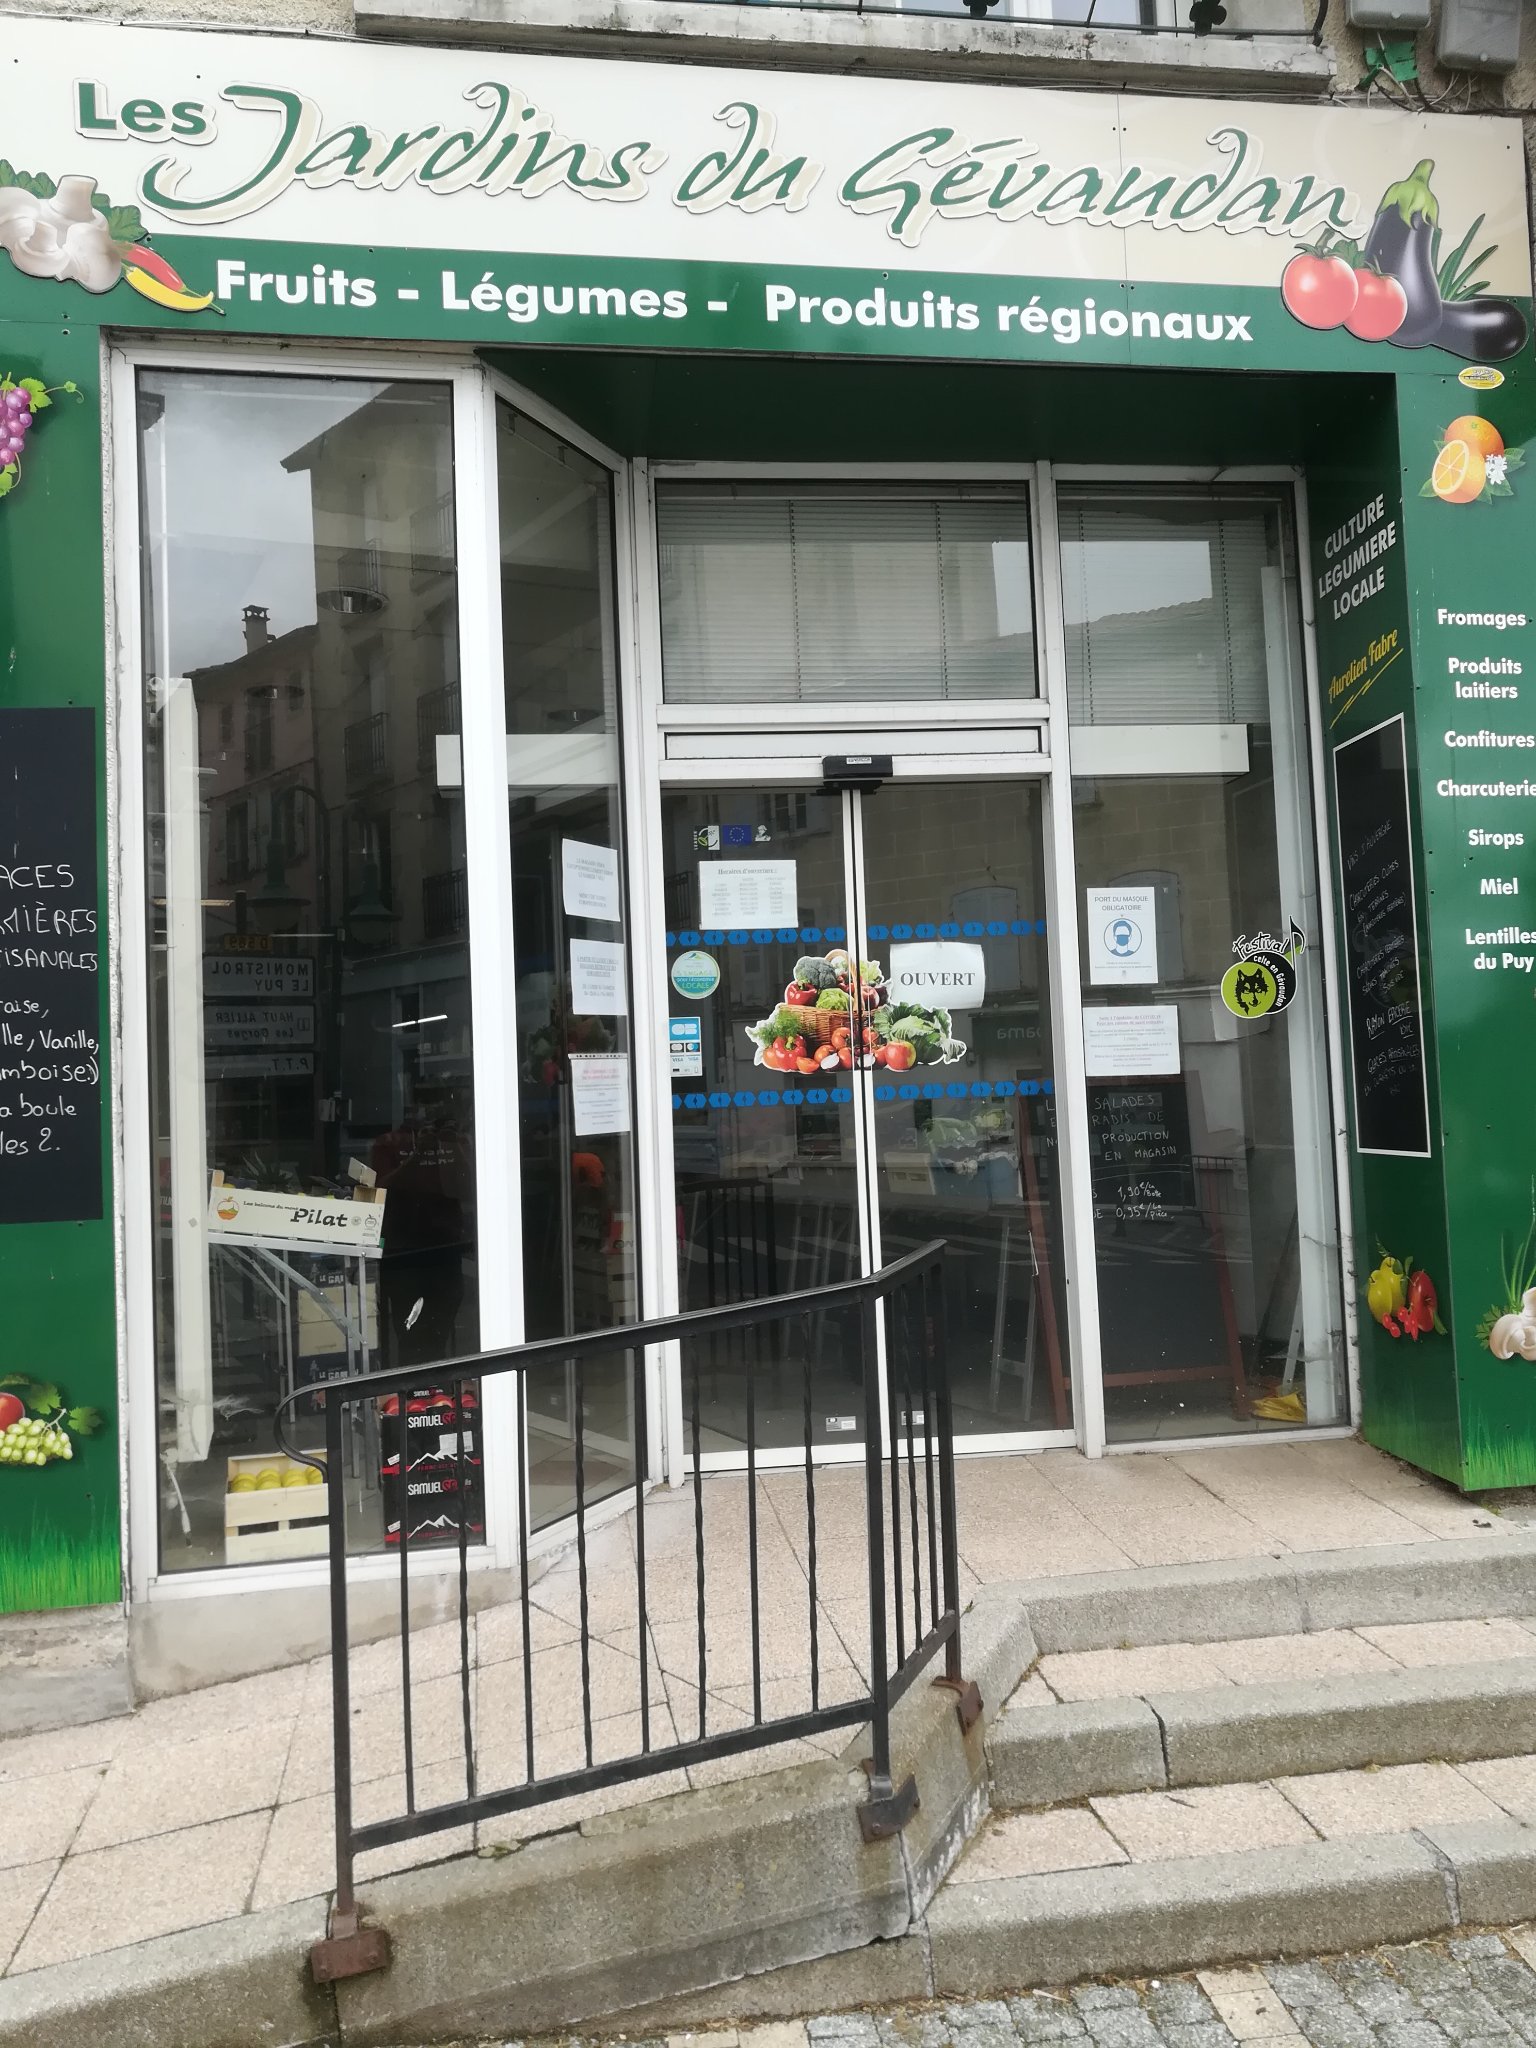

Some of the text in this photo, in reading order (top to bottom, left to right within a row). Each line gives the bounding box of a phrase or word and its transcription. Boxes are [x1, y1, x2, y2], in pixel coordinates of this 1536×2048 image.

[79, 82, 1364, 235] Les Jardins du Gévaudan
[216, 260, 377, 307] Fruits
[442, 271, 688, 323] Légumes
[765, 285, 980, 332] Produits
[998, 296, 1254, 345] régionaux
[1324, 493, 1385, 559] CULTURE
[1318, 520, 1396, 599] LEGUMIERE
[1333, 566, 1385, 621] LOCALE
[1437, 608, 1527, 630] Fromages
[1368, 629, 1398, 667] Fabre
[1448, 656, 1522, 675] Produits
[1455, 680, 1518, 699] laitiers
[1444, 729, 1536, 748] Confitures
[1468, 829, 1524, 850] Sirops
[1480, 877, 1519, 895] Miel
[1101, 904, 1142, 912] OBLIGATOIRE
[1122, 895, 1149, 903] MASQUE
[1465, 926, 1536, 945] Lentilles
[1232, 932, 1290, 961] Festival
[0, 948, 98, 971] ISANALES
[1473, 952, 1535, 973] du Puy
[900, 972, 975, 986] OUVERT
[0, 1000, 49, 1018] aise,
[39, 1029, 99, 1055] Vanille,
[20, 1093, 77, 1117] boule
[1095, 1095, 1155, 1111] SALADES
[1092, 1110, 1164, 1127] RADIS DE
[1102, 1130, 1169, 1144] PRODUCTION
[1105, 1145, 1177, 1161] EN MAGASIN
[289, 1207, 348, 1228] Pilat
[407, 1414, 444, 1429] SAMUEL
[407, 1480, 444, 1496] SAMUEL
